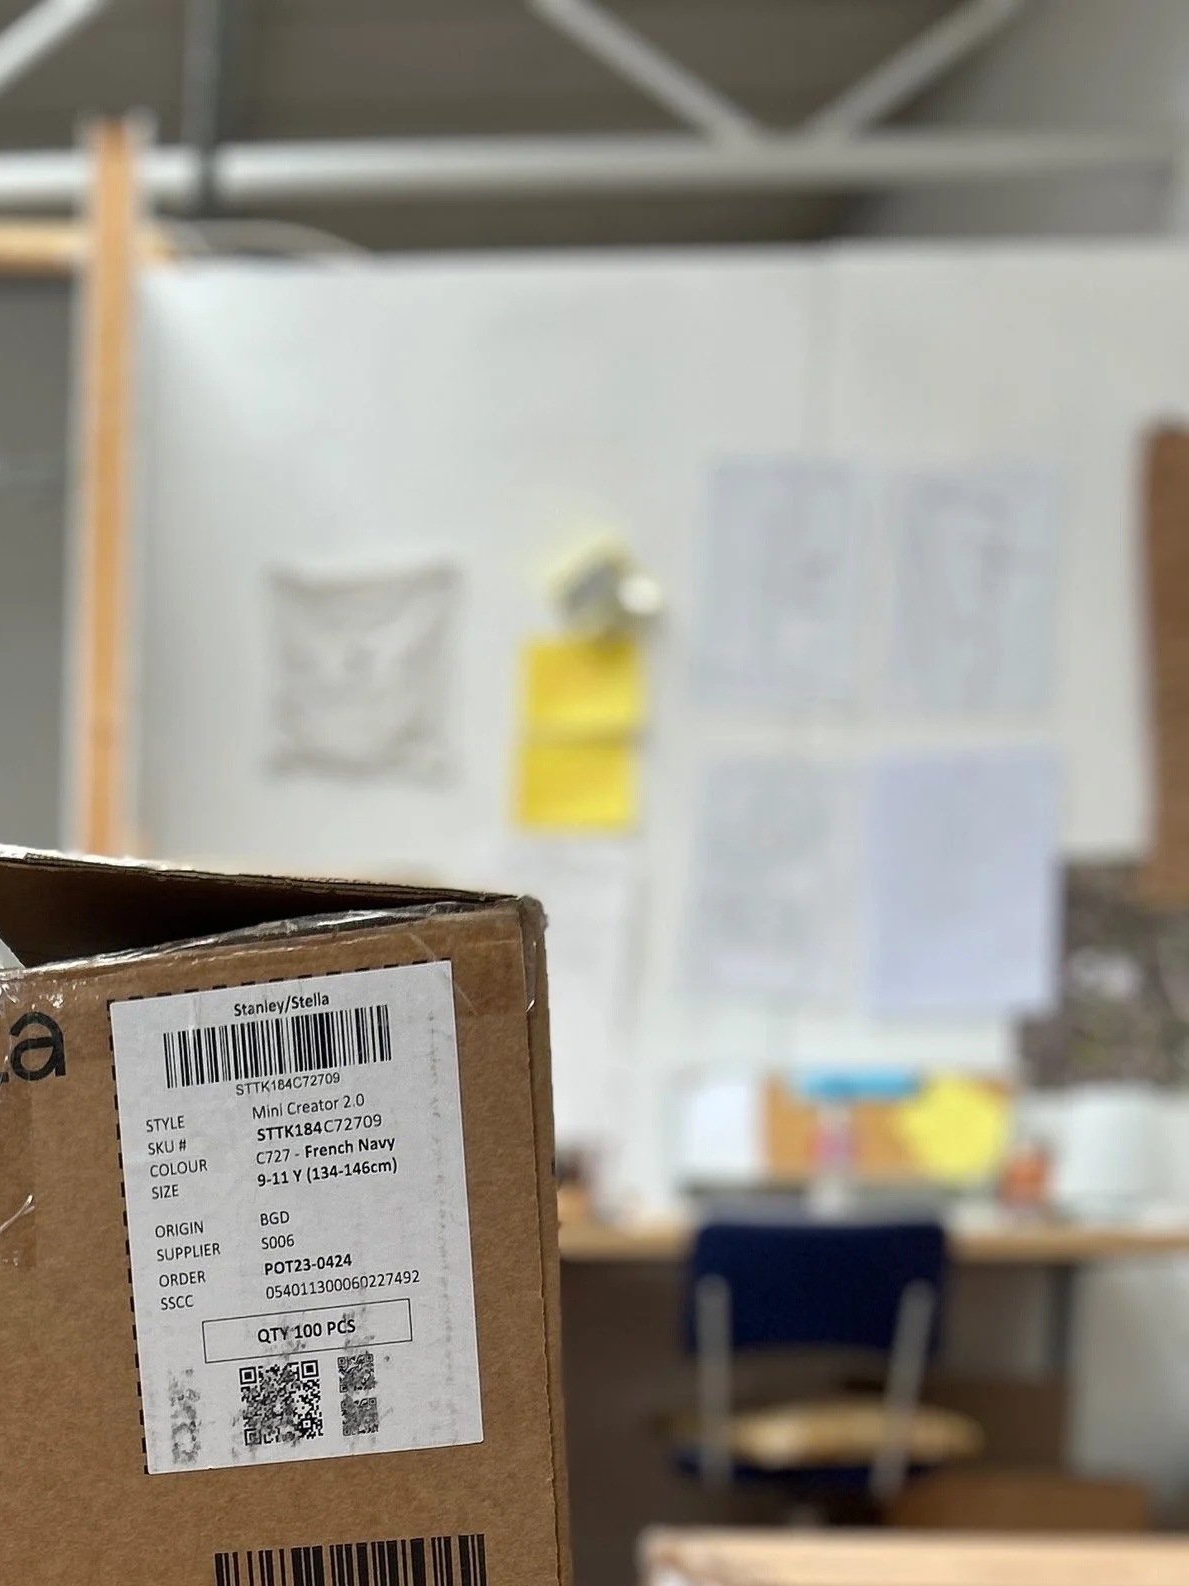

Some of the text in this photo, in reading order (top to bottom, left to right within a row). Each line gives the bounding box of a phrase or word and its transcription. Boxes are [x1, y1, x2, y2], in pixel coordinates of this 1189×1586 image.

[233, 992, 330, 1017] Stanley/Stella
[236, 1073, 341, 1096] STTK184C72709
[252, 1094, 365, 1120] Mini Creator 2.0
[146, 1115, 185, 1132] STYLE
[257, 1114, 382, 1142] STTK184C72709
[148, 1139, 187, 1156] SKU #
[256, 1149, 290, 1165] C727
[305, 1140, 354, 1158] French
[358, 1136, 396, 1154] Navy
[150, 1159, 208, 1178] COLOUR
[258, 1157, 398, 1187] 9-11 Y (134-146cm)
[152, 1184, 179, 1200] SIZE
[260, 1210, 290, 1227] BGD
[155, 1220, 205, 1238] ORIGIN
[156, 1242, 221, 1262] SUPPLIER
[261, 1234, 295, 1250] S006
[264, 1253, 352, 1275] POT23-0424
[159, 1271, 206, 1288] ORDER
[266, 1270, 420, 1300] 054011300060227492
[160, 1295, 194, 1310] SSCC
[257, 1319, 356, 1344] QTY 100 PCS
